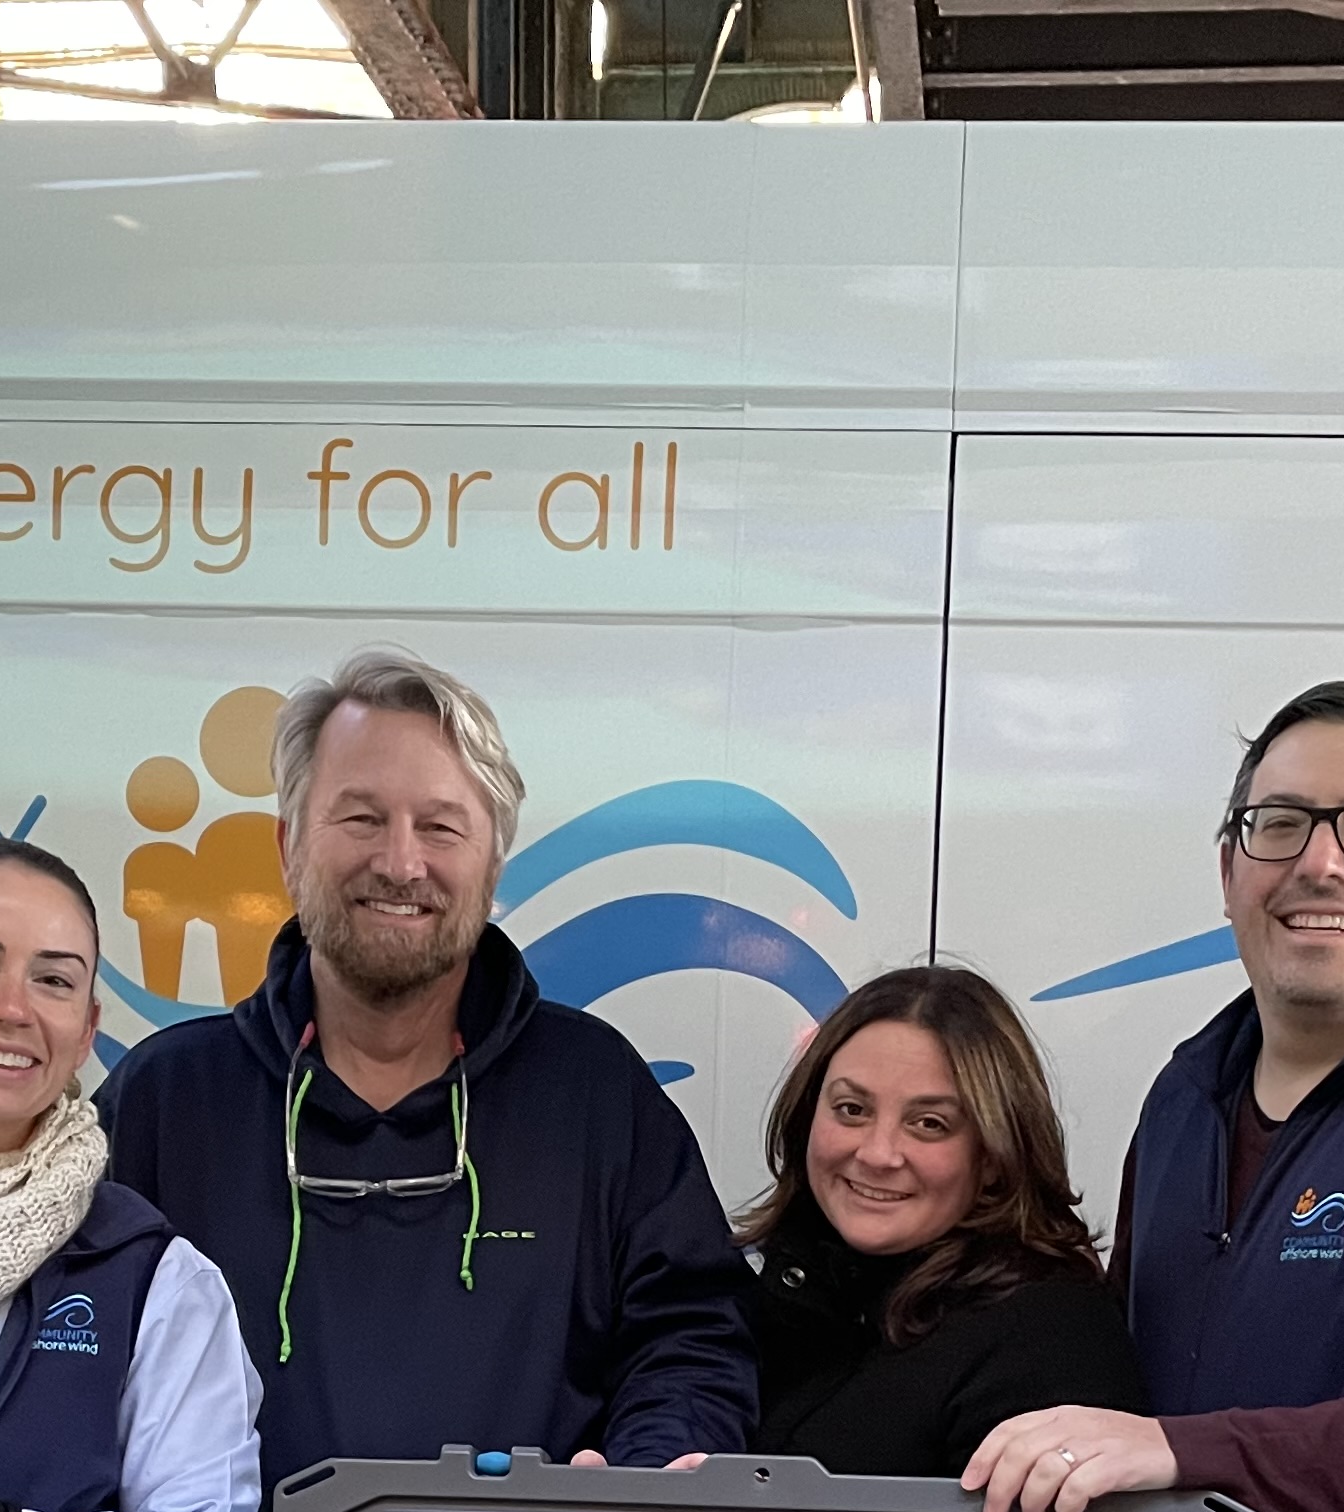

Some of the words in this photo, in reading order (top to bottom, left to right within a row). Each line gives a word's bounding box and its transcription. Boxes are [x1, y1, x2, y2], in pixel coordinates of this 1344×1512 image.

[306, 437, 492, 551] for
[536, 440, 679, 552] all
[67, 1339, 99, 1356] wind
